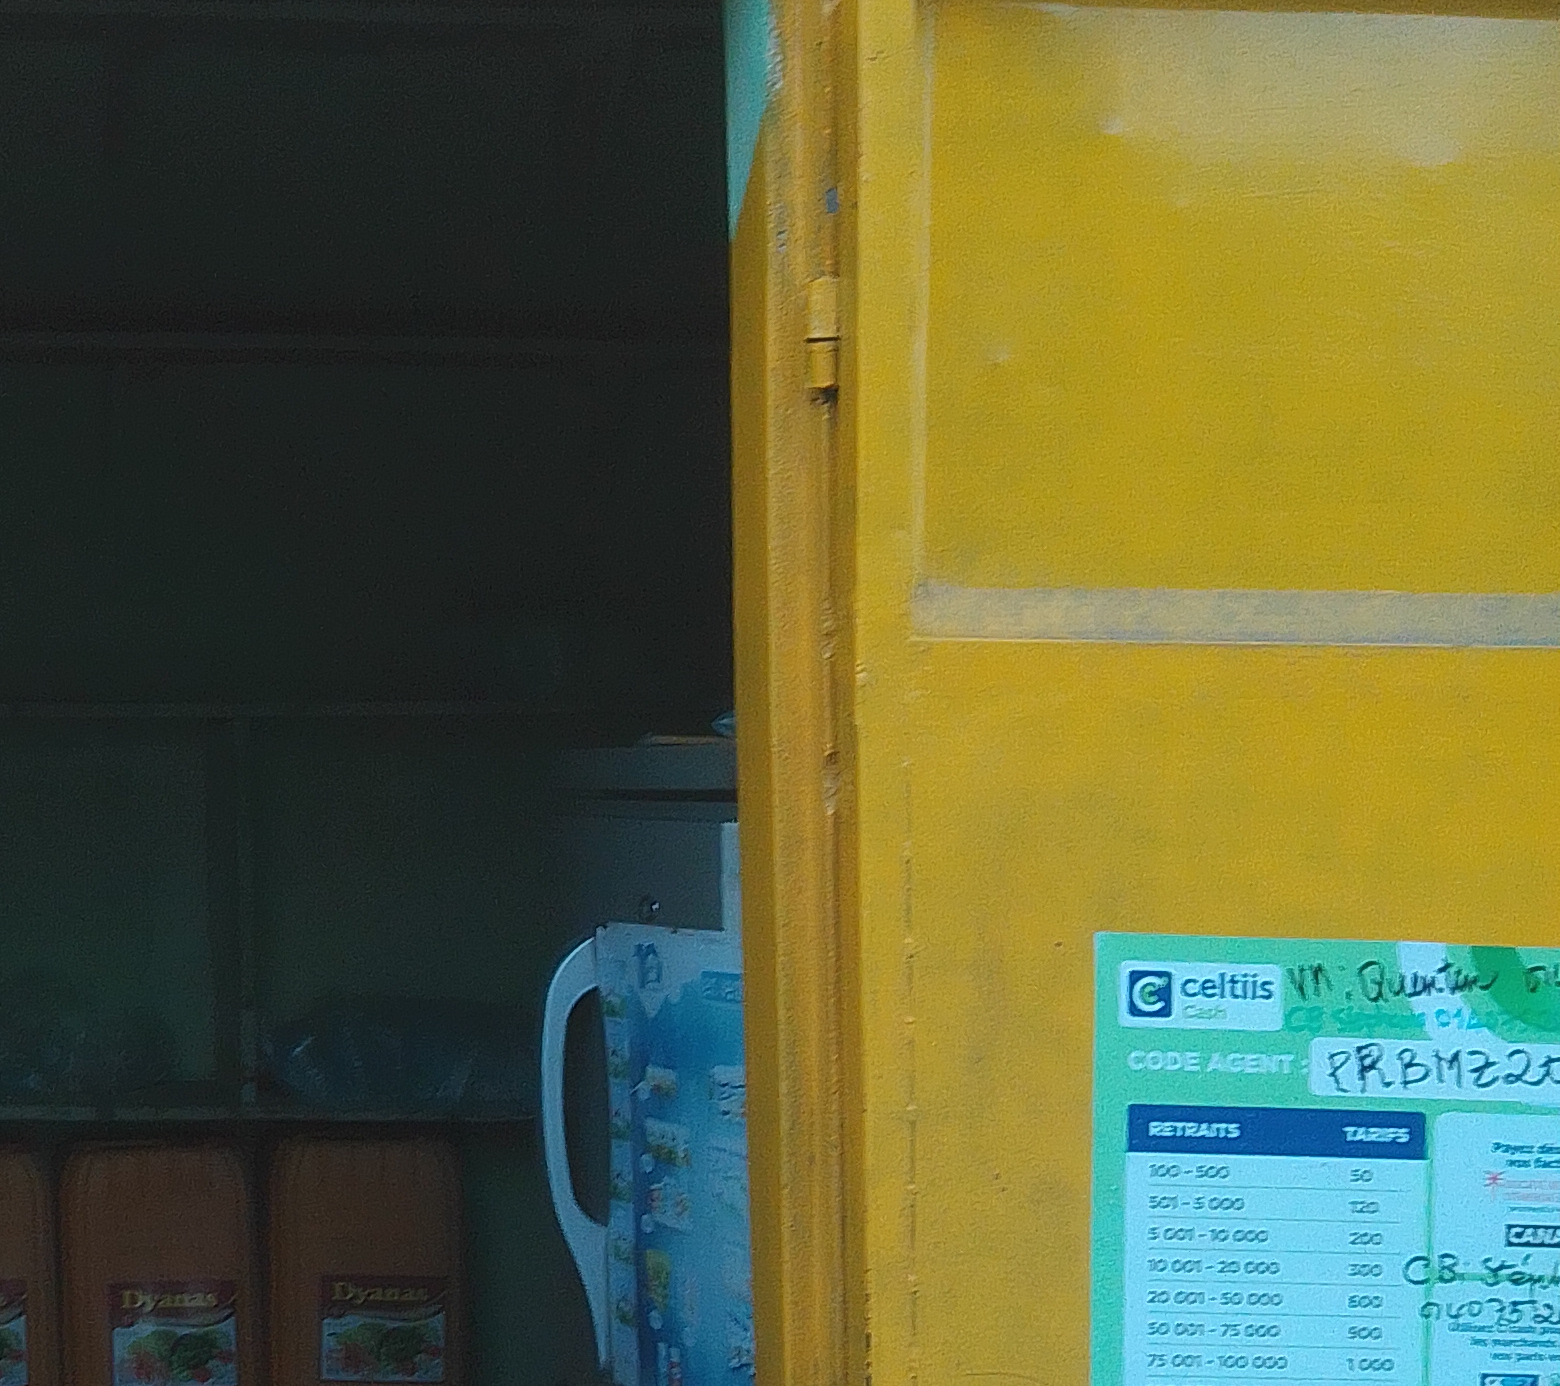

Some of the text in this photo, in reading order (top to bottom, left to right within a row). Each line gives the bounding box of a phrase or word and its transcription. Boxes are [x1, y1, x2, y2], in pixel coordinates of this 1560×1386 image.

[1180, 971, 1275, 1001] celtiis
[1127, 1050, 1295, 1074] CODE AGENT
[120, 1289, 219, 1312] Dyanas
